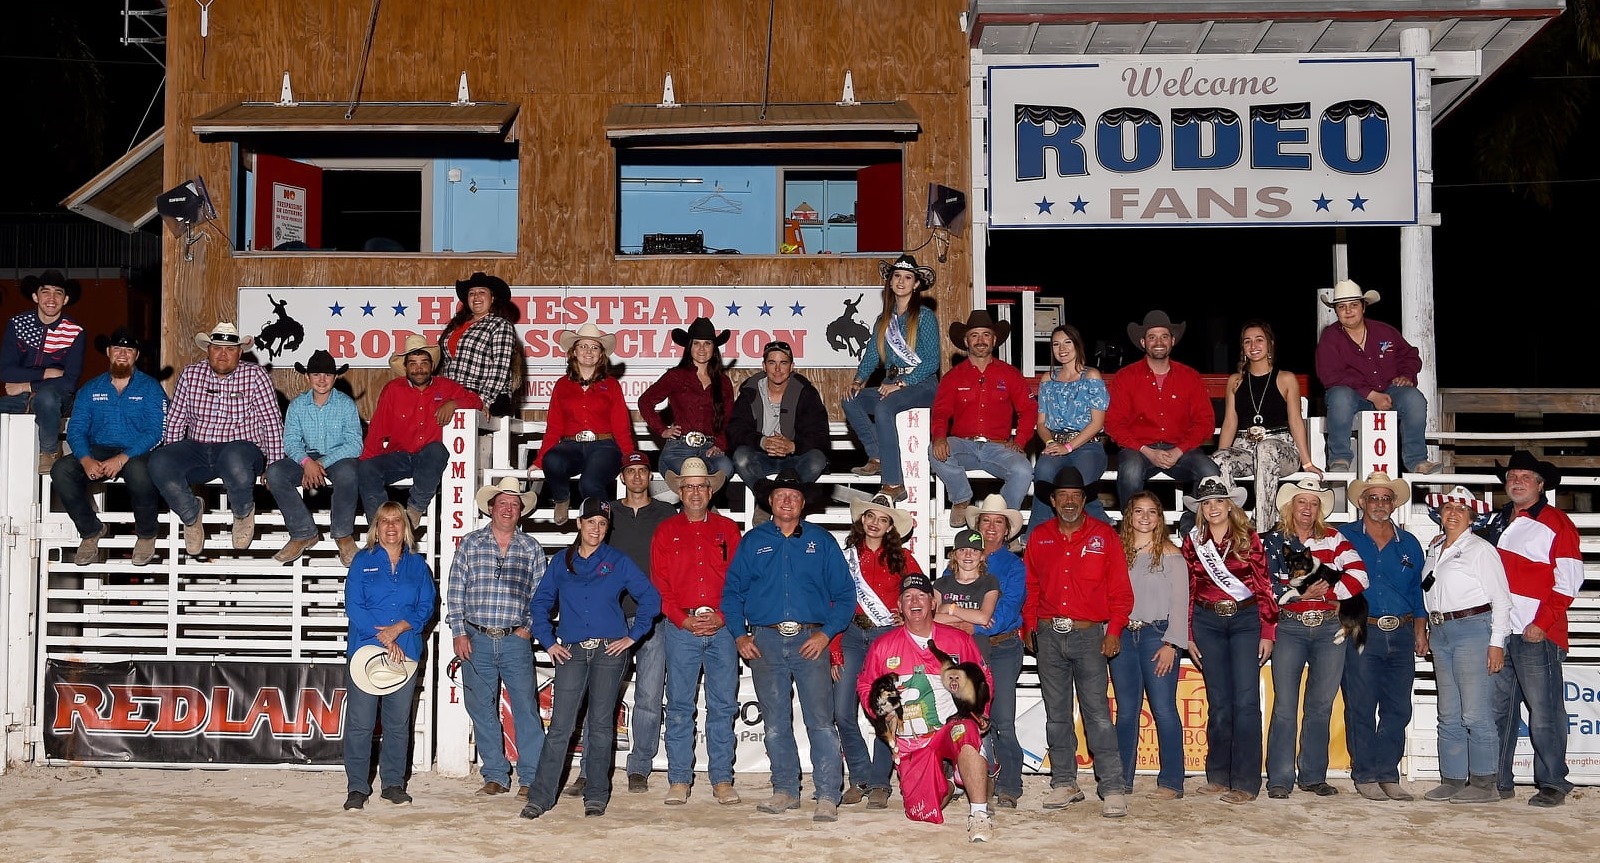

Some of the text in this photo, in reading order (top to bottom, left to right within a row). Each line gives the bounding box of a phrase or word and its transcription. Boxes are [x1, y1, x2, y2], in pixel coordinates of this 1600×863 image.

[1121, 66, 1278, 97] Welcome
[1014, 99, 1390, 182] RODEO
[283, 189, 296, 200] NO
[1109, 186, 1293, 220] FANS
[417, 296, 715, 325] HESTEAD
[943, 592, 971, 601] GIRLS
[956, 601, 980, 609] WILL
[52, 682, 347, 740] REDLAN
